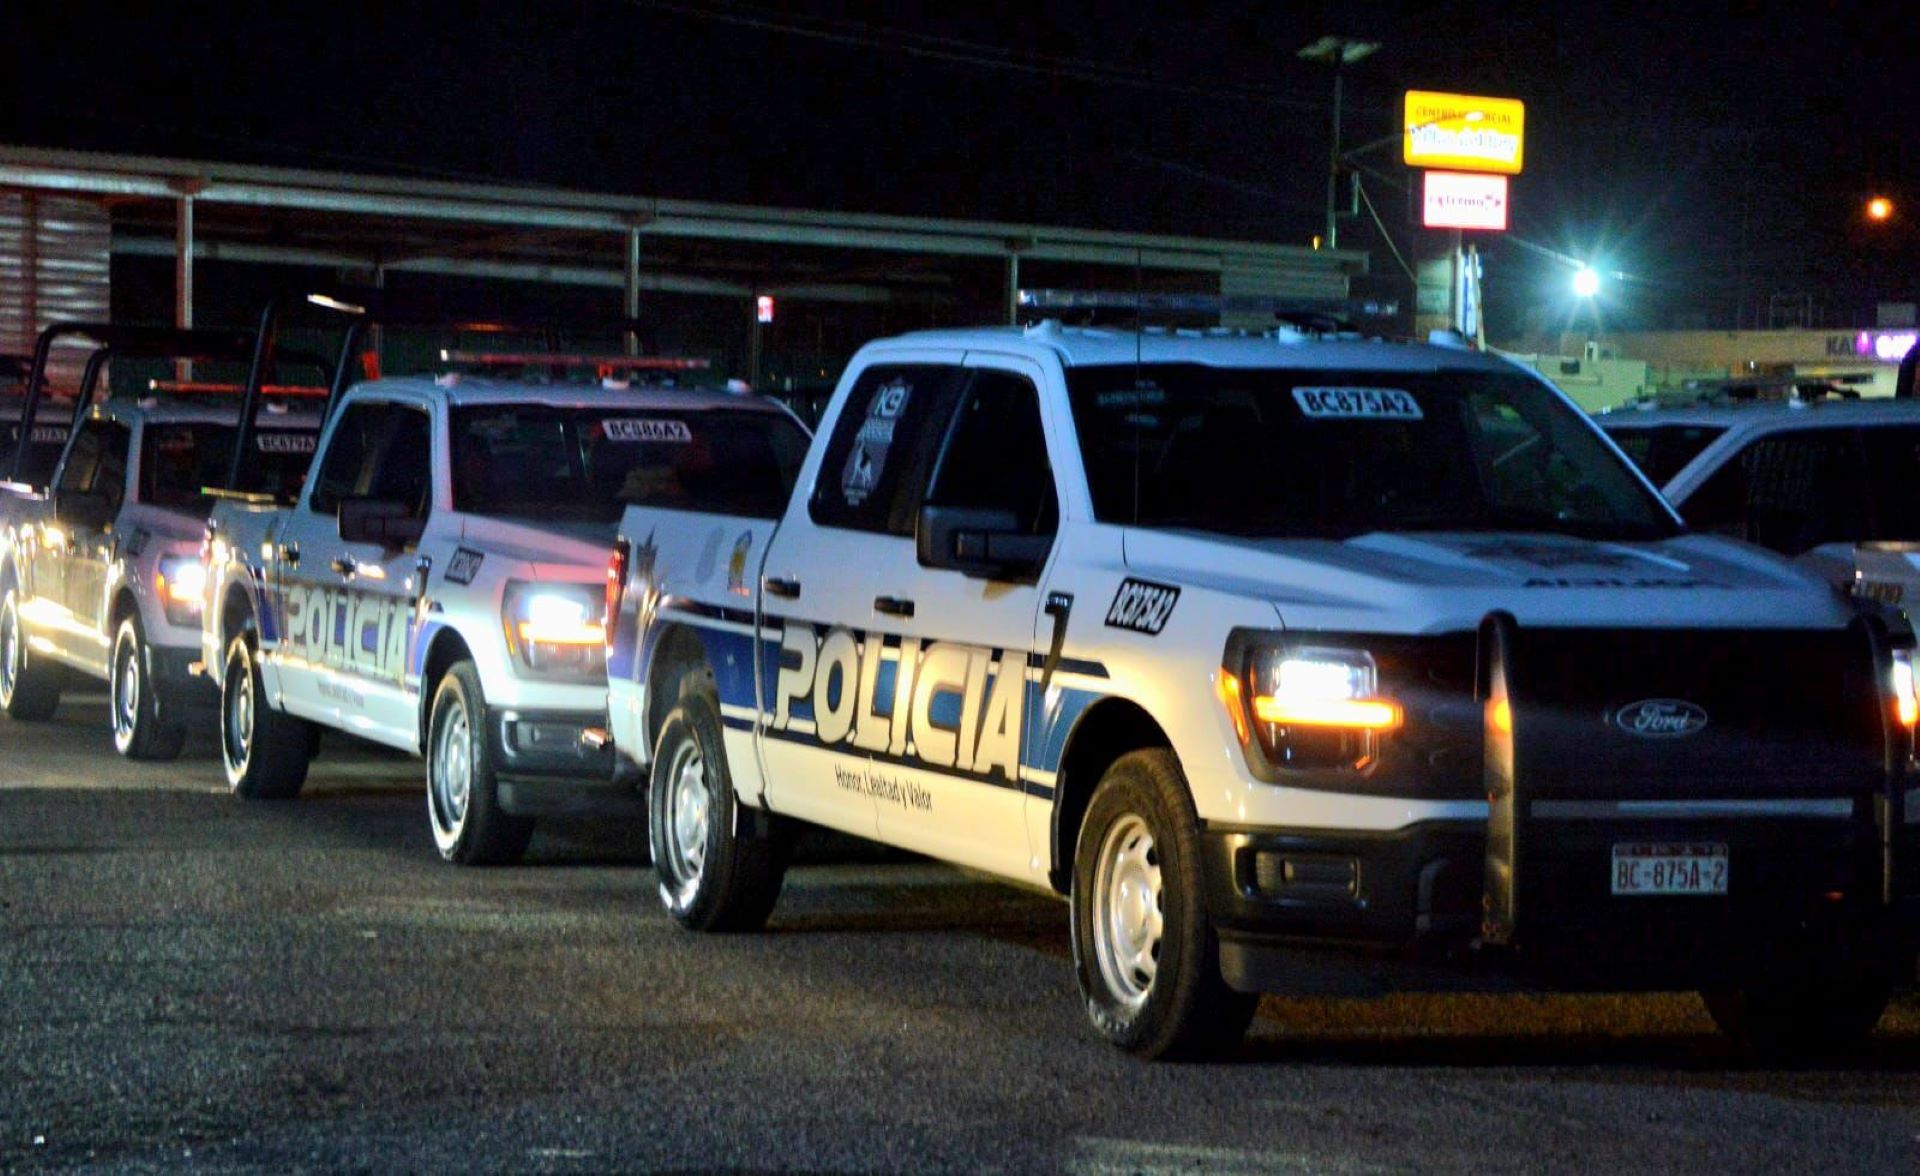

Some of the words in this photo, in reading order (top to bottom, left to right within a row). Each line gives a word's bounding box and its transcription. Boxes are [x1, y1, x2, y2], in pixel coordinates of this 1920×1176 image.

[1303, 390, 1415, 413] BC875A2
[285, 584, 408, 688] POLICIA
[773, 618, 1027, 782] POLICIA
[1635, 703, 1690, 734] Ford
